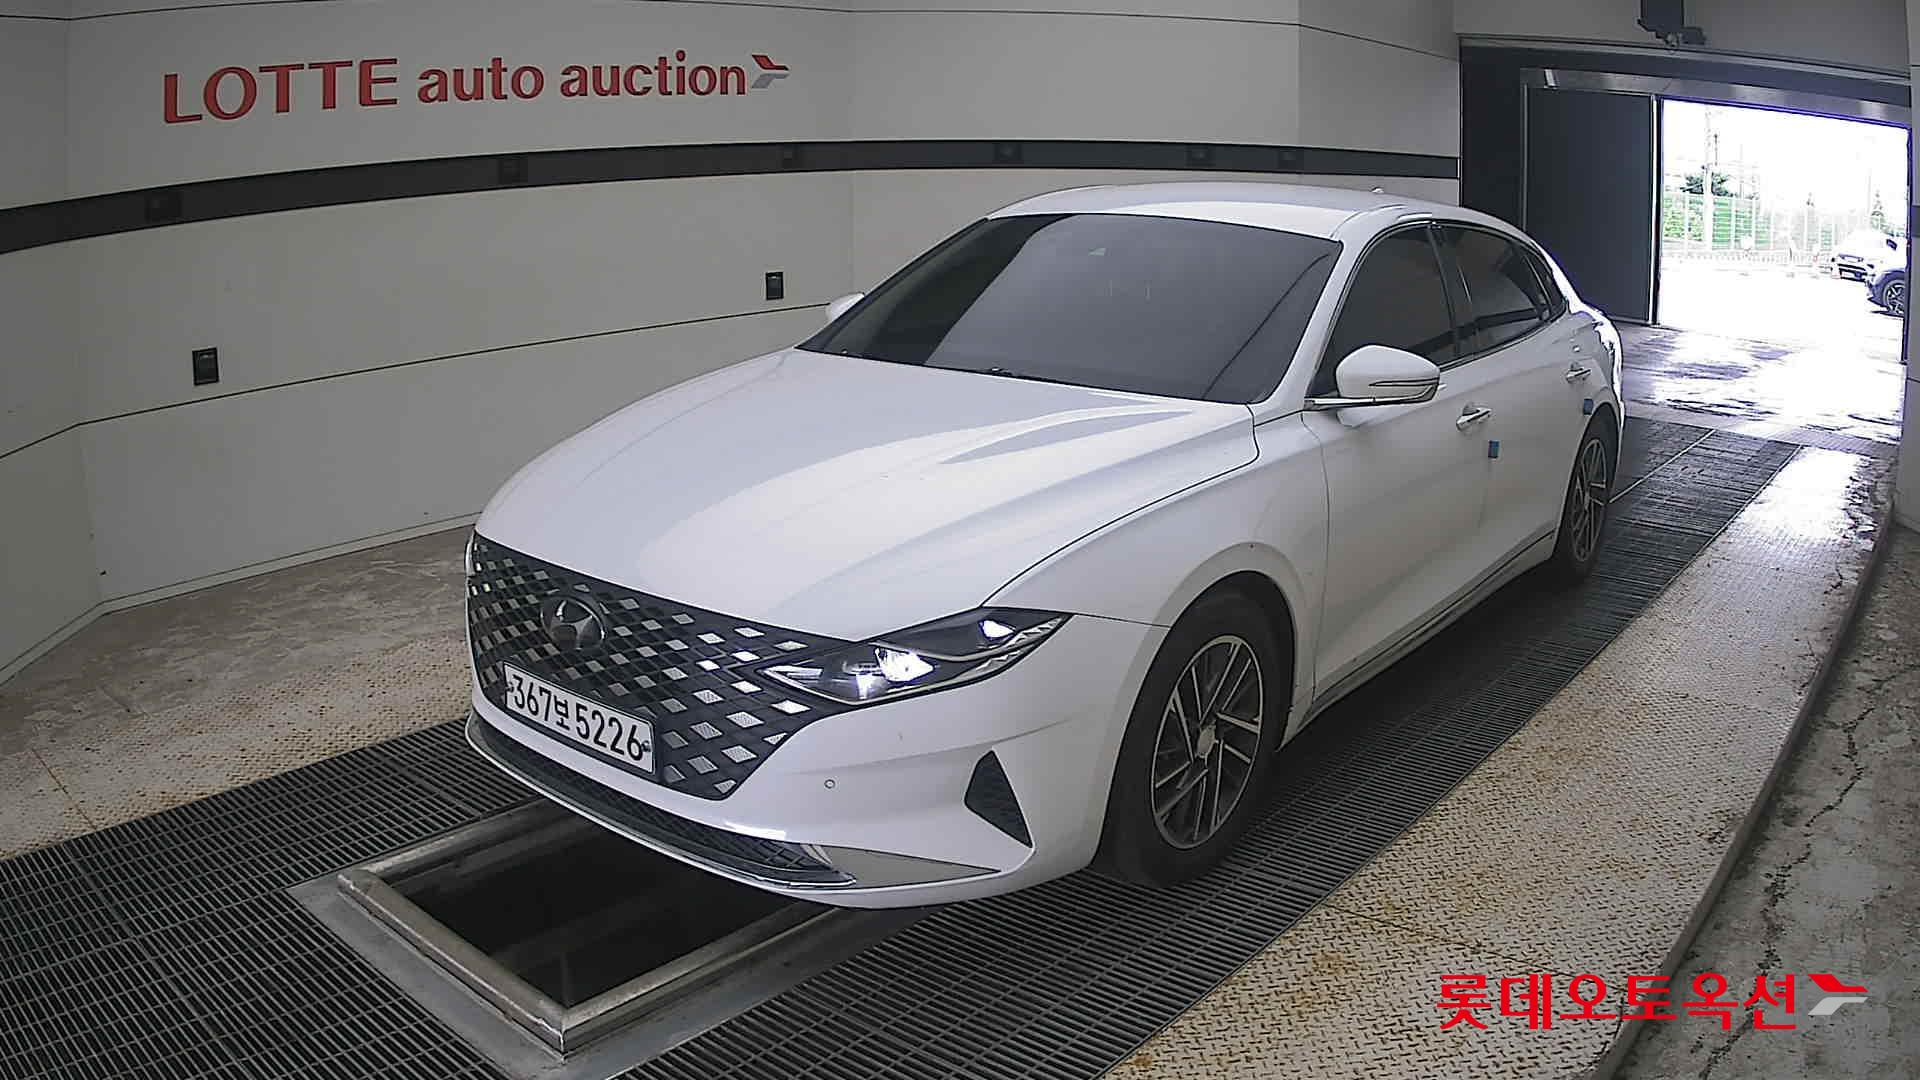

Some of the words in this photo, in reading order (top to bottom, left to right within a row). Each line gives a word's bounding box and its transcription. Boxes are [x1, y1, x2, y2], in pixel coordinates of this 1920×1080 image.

[163, 58, 398, 124] LOTTE
[417, 57, 545, 103] auto
[559, 50, 748, 98] auction
